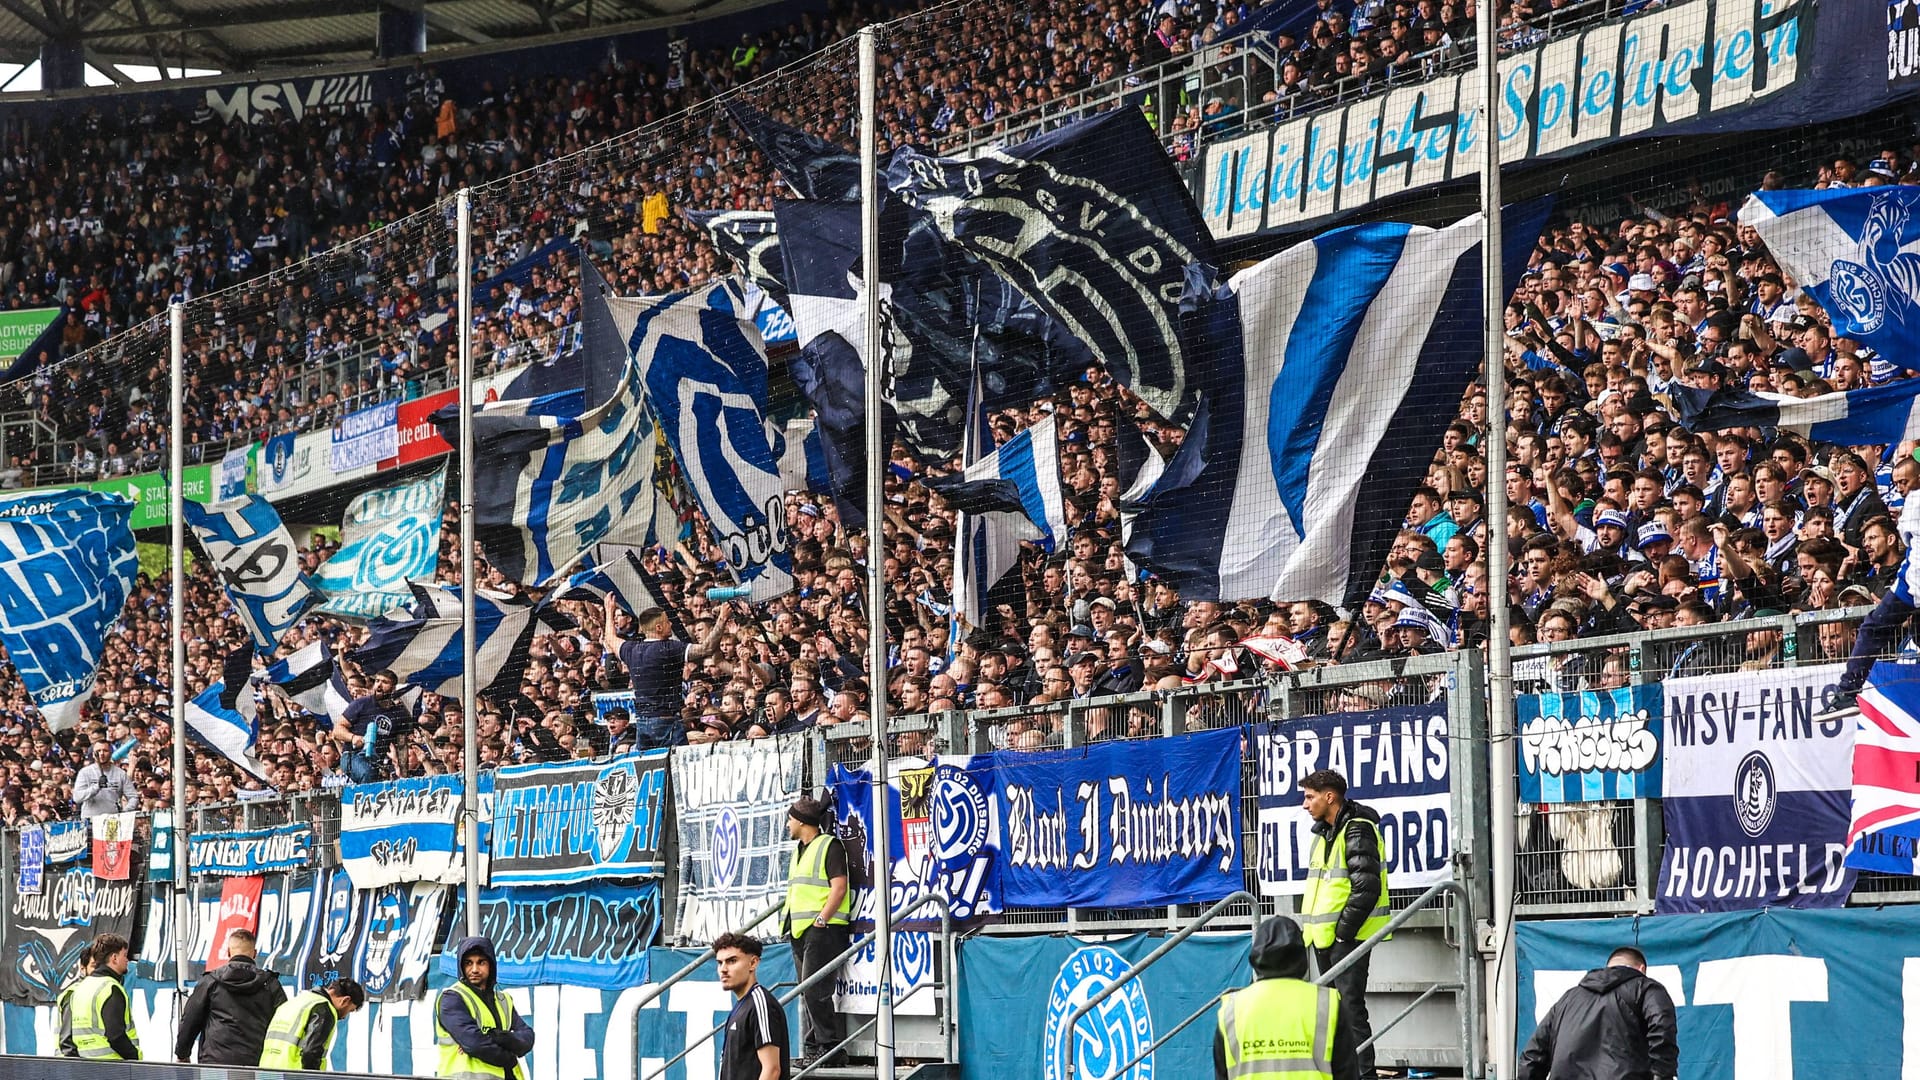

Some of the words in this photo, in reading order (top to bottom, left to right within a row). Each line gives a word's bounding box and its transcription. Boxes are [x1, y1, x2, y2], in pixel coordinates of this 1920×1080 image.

[206, 79, 325, 125] MSV
[1634, 175, 1735, 213] WDAUSTDION
[146, 480, 205, 502] STADERKE
[1671, 684, 1844, 747] MSV-FANS
[492, 780, 597, 862] METROPOL
[953, 772, 969, 787] 02
[967, 784, 987, 857] DUISBURG
[1108, 773, 1236, 873] Duisburg
[1664, 843, 1847, 899] HOCHFELD
[53, 876, 134, 921] Gation
[1093, 952, 1114, 977] 02
